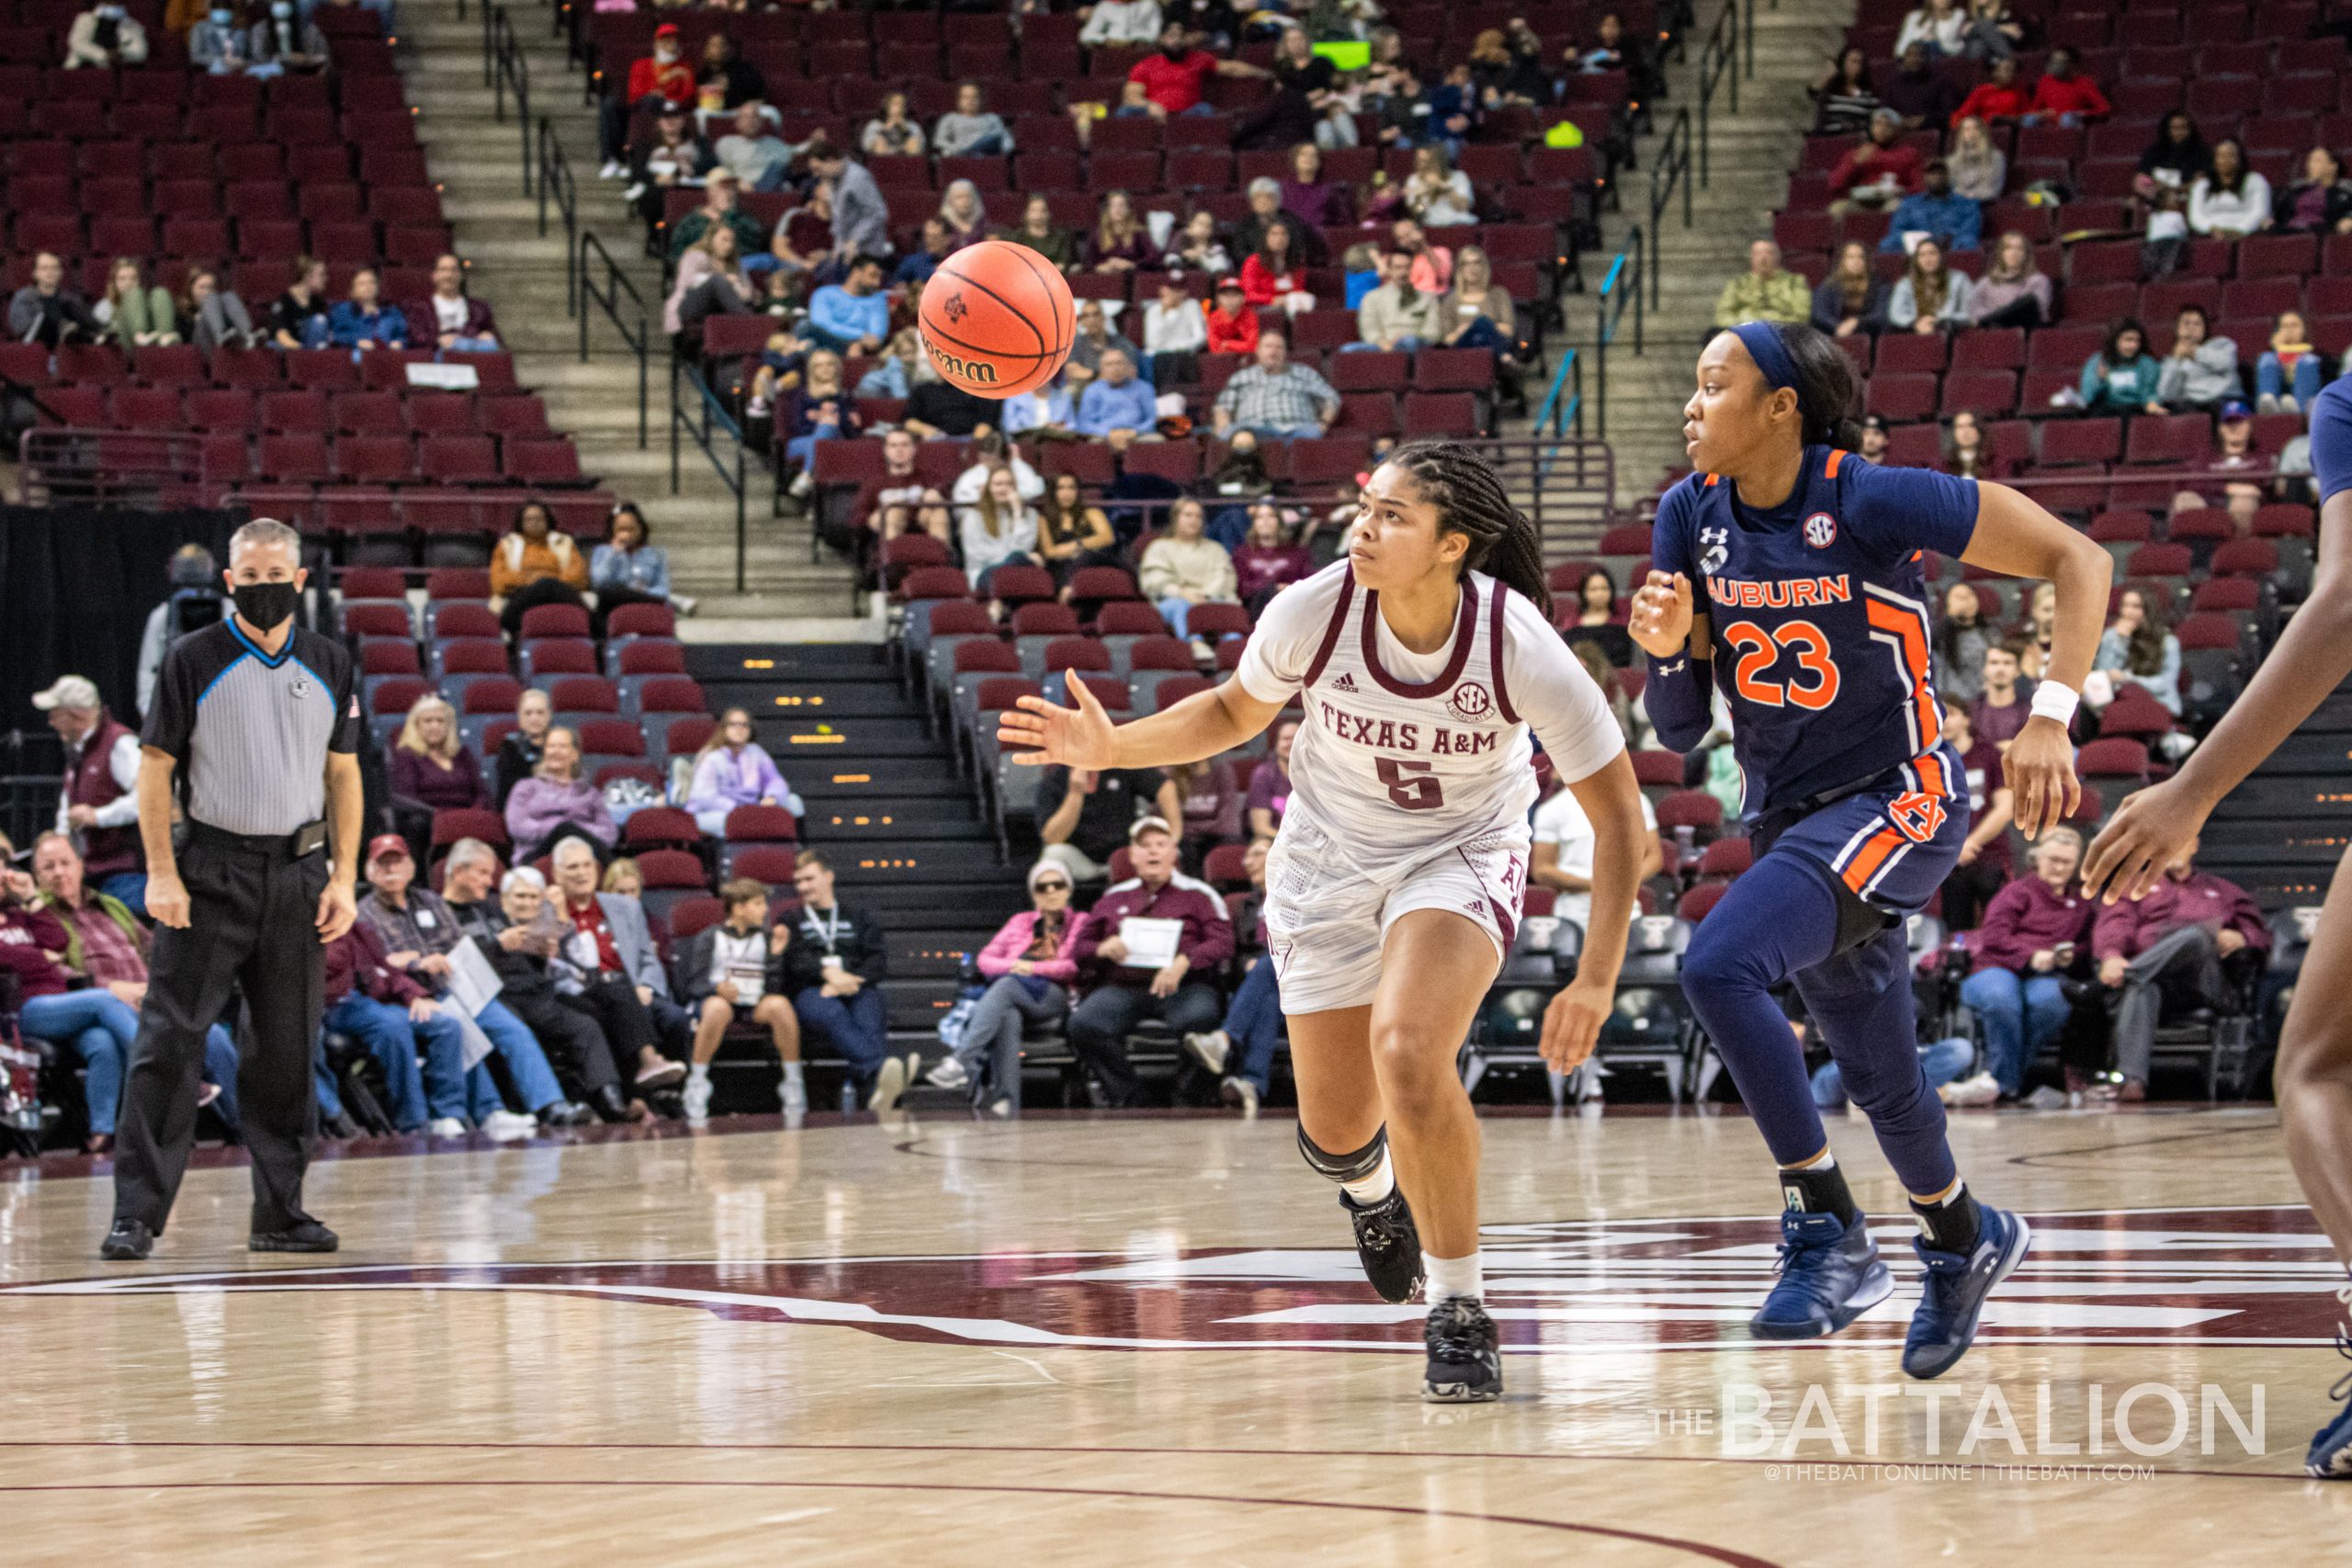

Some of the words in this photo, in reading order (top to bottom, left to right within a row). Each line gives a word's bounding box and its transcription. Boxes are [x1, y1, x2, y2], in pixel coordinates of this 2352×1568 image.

[1806, 514, 1835, 546] SEC
[1707, 573, 1853, 608] AUBURN
[1724, 620, 1841, 711] 23
[1331, 682, 1359, 694] adidas
[1455, 683, 1487, 713] SEC
[1321, 700, 1419, 751] TEXAS
[1431, 727, 1498, 755] A&M
[1374, 756, 1444, 810] 5
